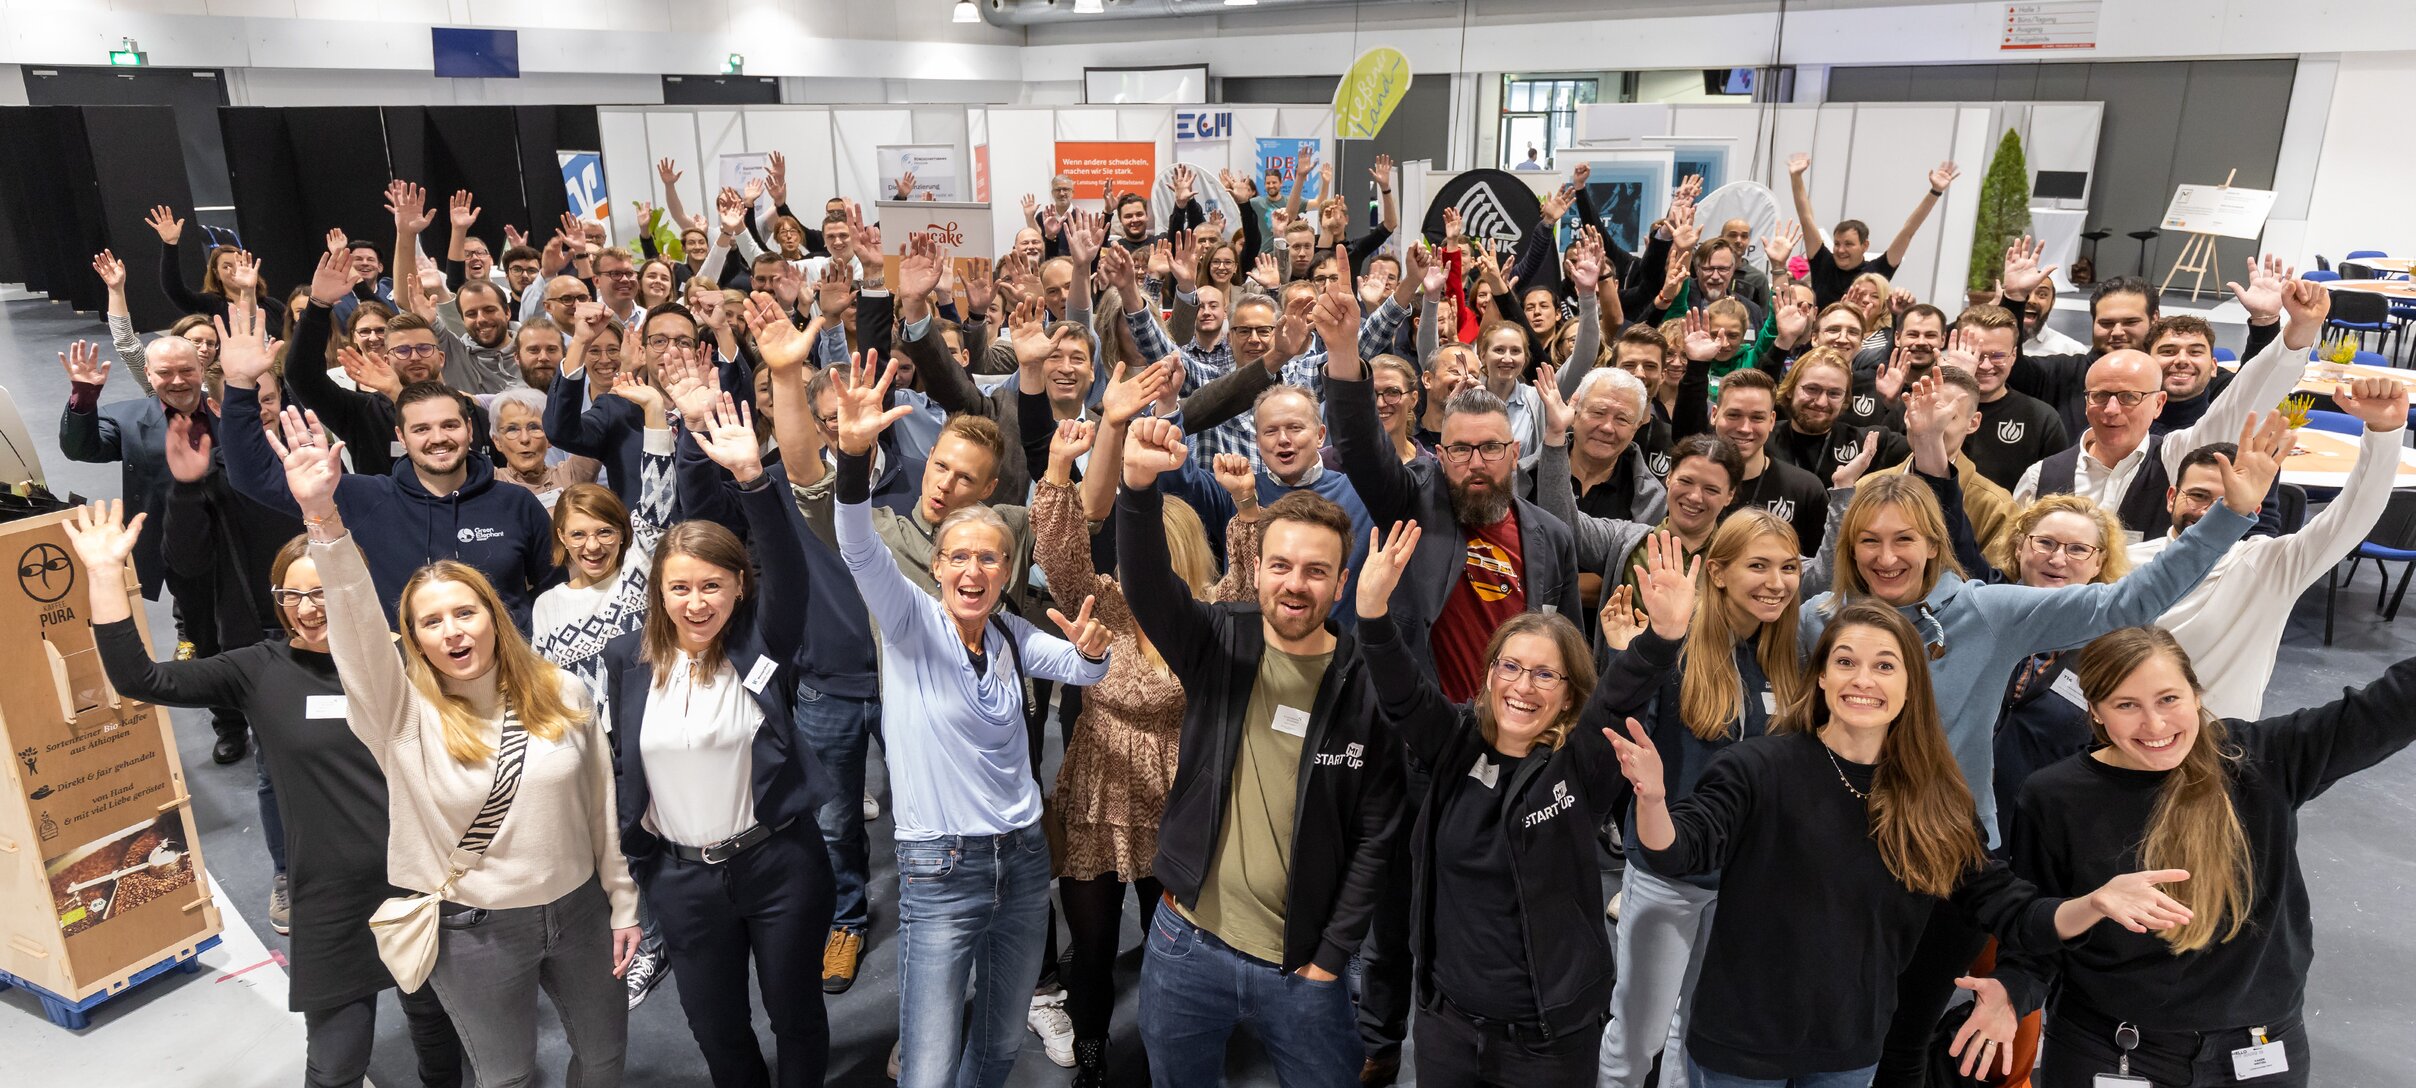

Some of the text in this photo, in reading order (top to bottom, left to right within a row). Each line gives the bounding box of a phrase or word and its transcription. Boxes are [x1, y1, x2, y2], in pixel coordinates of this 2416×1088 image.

[1062, 158, 1149, 167] Wenn andere schwächeln,
[43, 601, 66, 612] KAFFEE
[40, 607, 75, 627] PURA
[46, 728, 102, 753] Sortenreiner
[70, 746, 86, 756] aus
[57, 751, 155, 792] Direkt & fair gehandelt
[1314, 753, 1364, 770] START UP
[92, 783, 134, 804] von Hand
[64, 782, 165, 826] & mit viel Liebe geröstet
[1522, 795, 1576, 828] START UP
